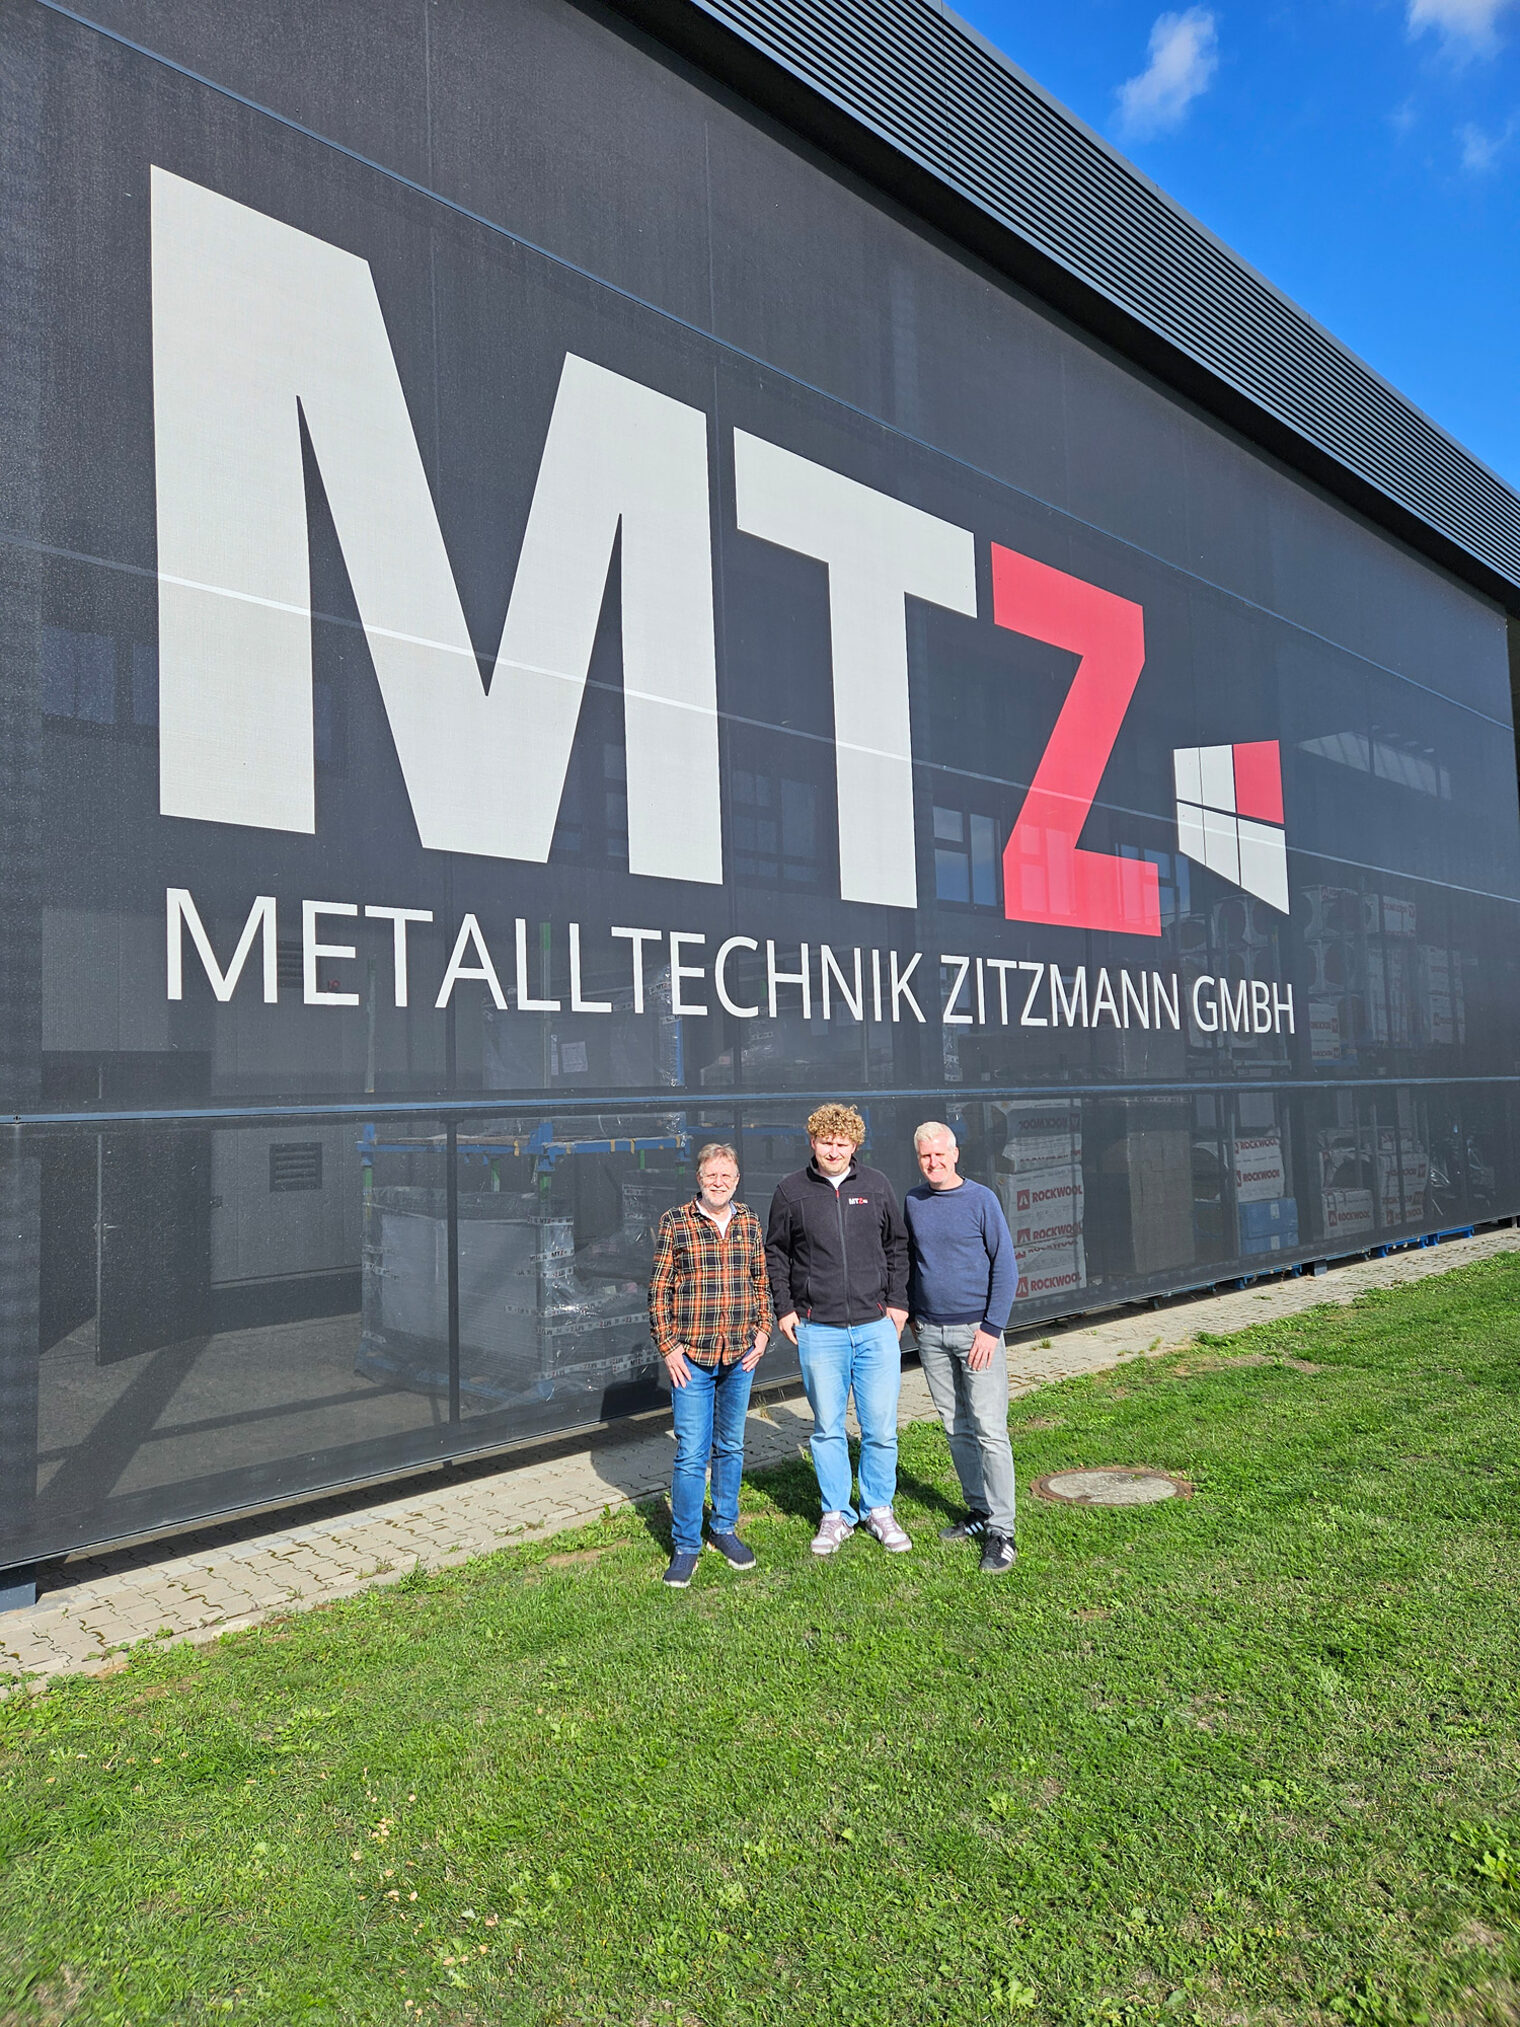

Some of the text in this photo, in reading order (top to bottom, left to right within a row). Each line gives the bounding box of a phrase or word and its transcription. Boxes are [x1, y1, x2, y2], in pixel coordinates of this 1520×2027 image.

[150, 165, 1162, 937] MTZ
[166, 887, 1295, 1035] METALLTECHNIK ZITZMANN GMBH
[1032, 1184, 1083, 1204] ROCKWOOL
[1030, 1272, 1082, 1292] ROCKWOOL
